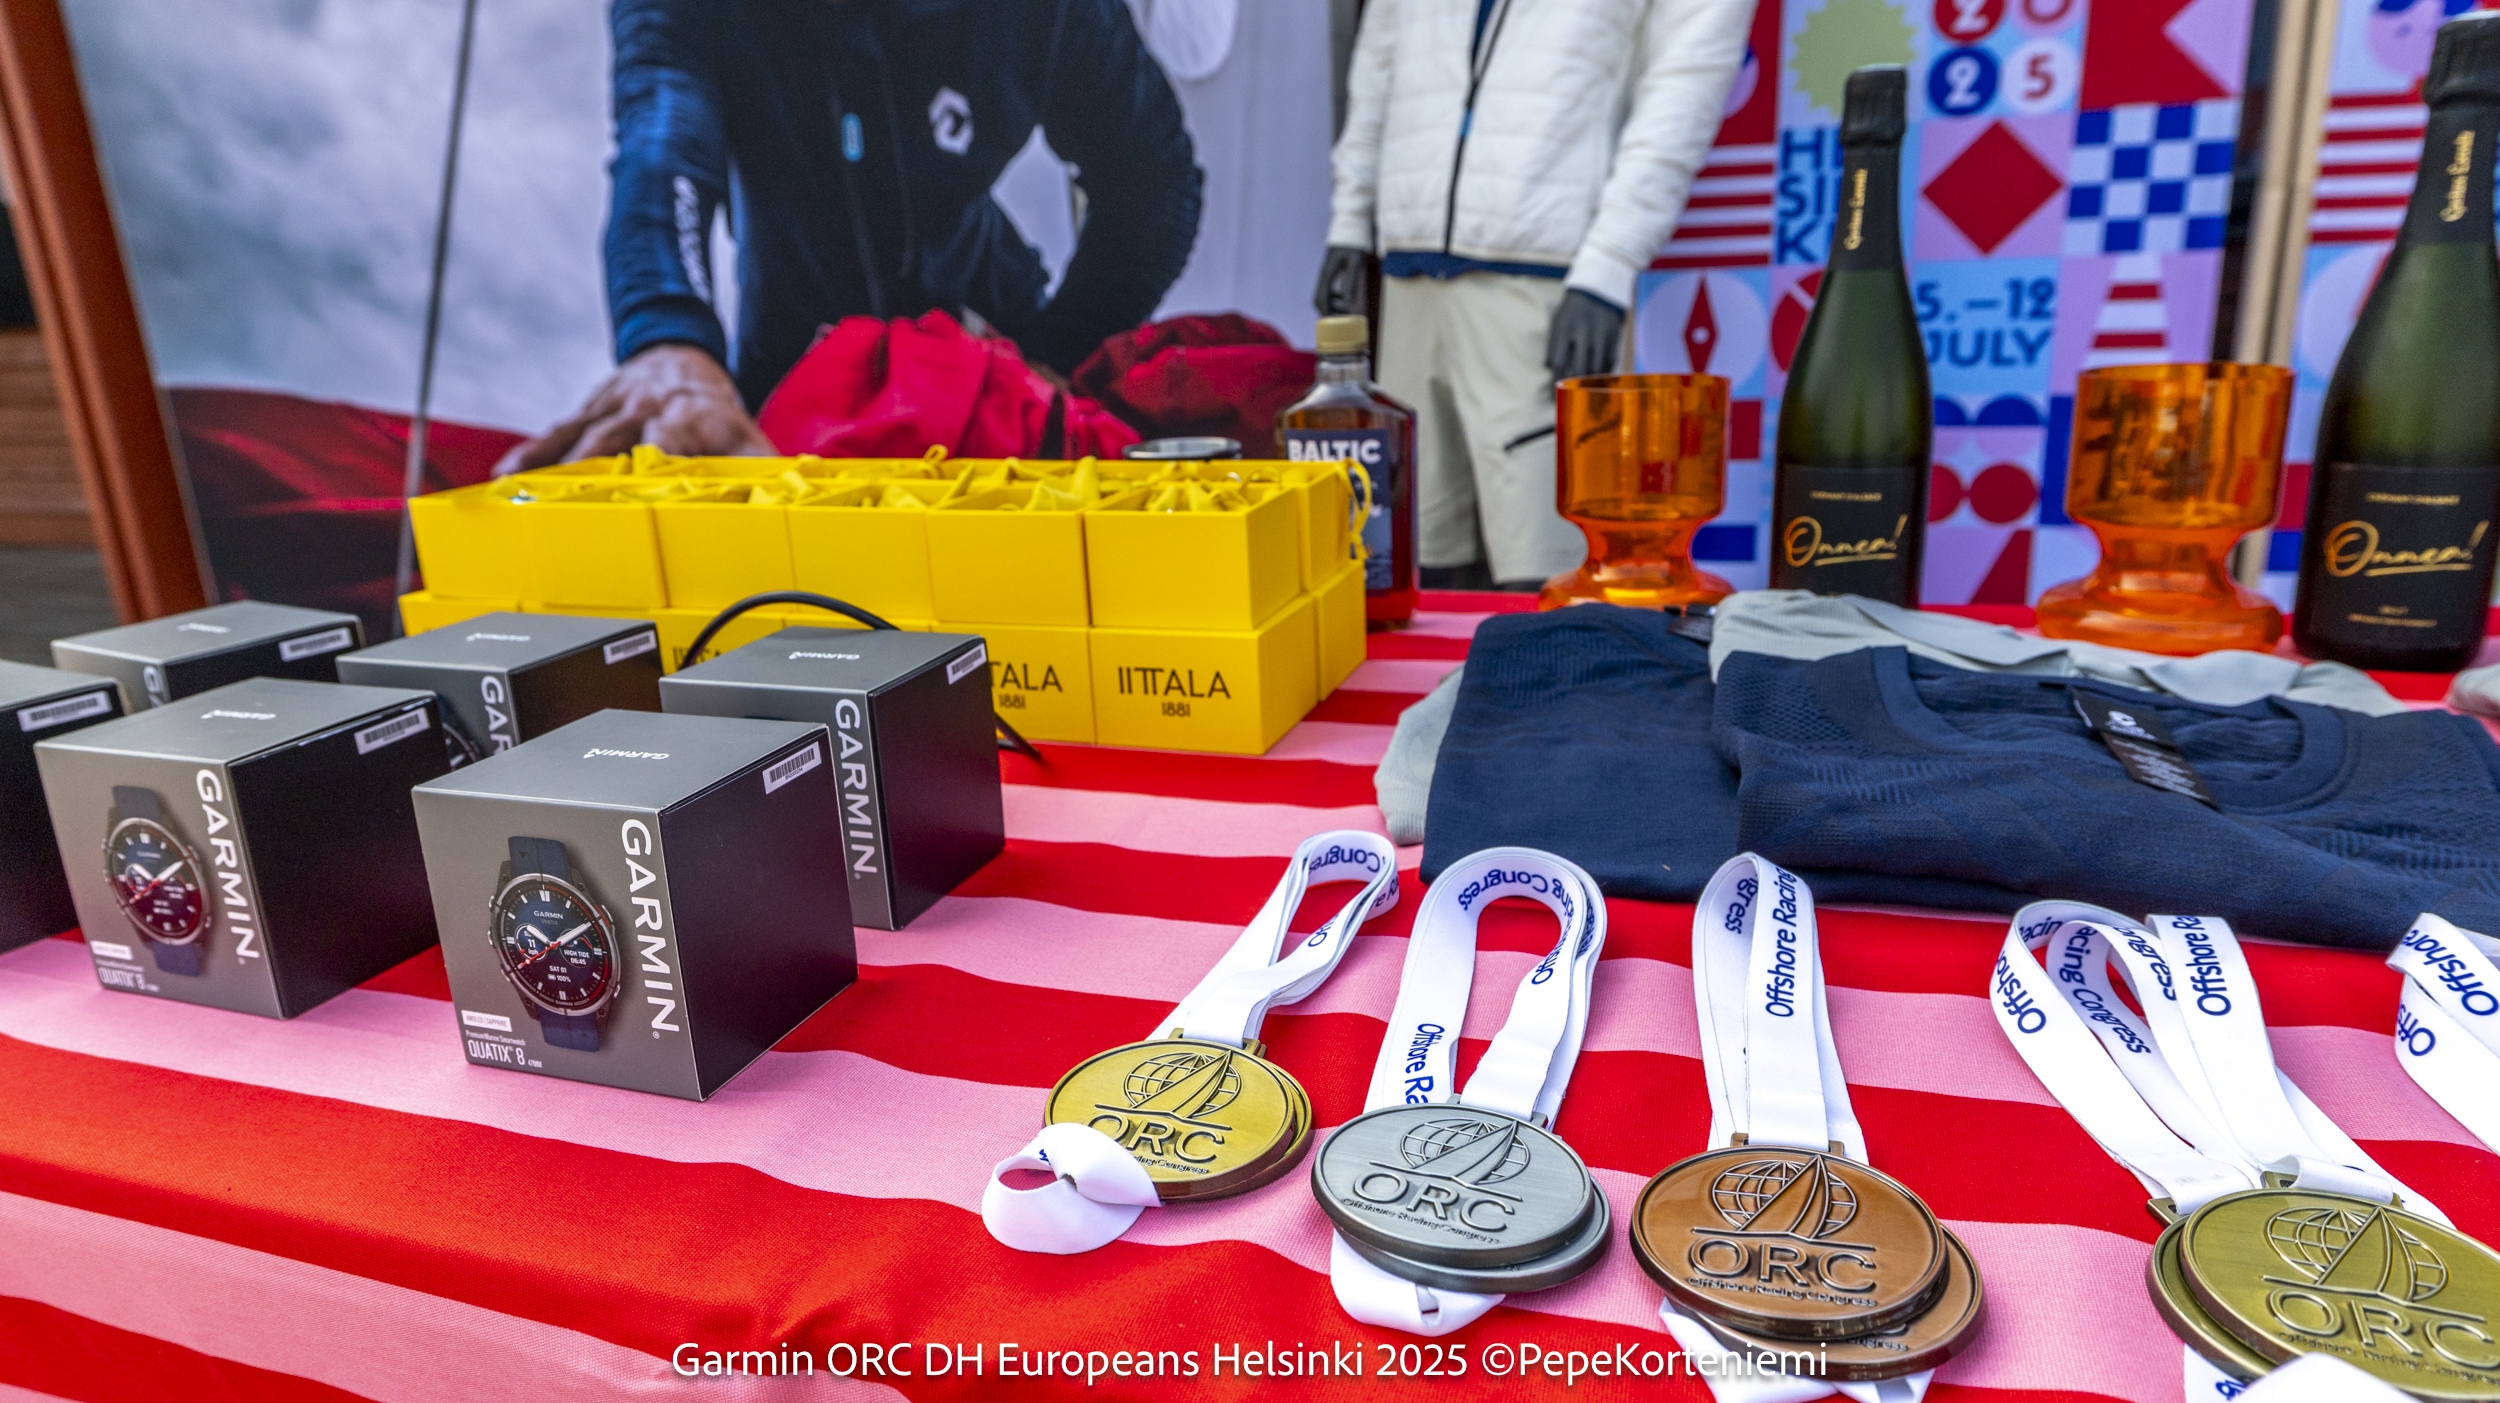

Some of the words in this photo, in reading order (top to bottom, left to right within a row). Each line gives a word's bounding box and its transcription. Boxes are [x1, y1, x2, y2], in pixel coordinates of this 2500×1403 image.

[1927, 330, 2051, 367] JULY
[1287, 438, 1381, 464] BALTIC
[1117, 666, 1232, 699] IITTALA
[1161, 702, 1191, 718] 1881
[586, 747, 670, 760] GARMIN
[835, 698, 878, 874] GARMIN
[196, 769, 260, 959] GARMIN
[1458, 868, 1549, 911] Congress
[533, 910, 564, 920] GARMIN
[1772, 867, 1797, 927] Racing
[1765, 928, 1797, 1018] Offshore
[2059, 926, 2097, 985] acing
[2184, 932, 2232, 1016] Offshore
[2073, 988, 2152, 1054] Congress
[515, 1047, 526, 1065] 8
[1405, 1023, 1445, 1074] Offshore
[1353, 1171, 1515, 1233] ORC
[1687, 1277, 1751, 1293] Offshore
[1755, 1284, 1804, 1299] Racing
[1806, 1290, 1878, 1307] Congress
[1690, 1238, 1878, 1293] ORC
[2267, 1287, 2500, 1370] ORC
